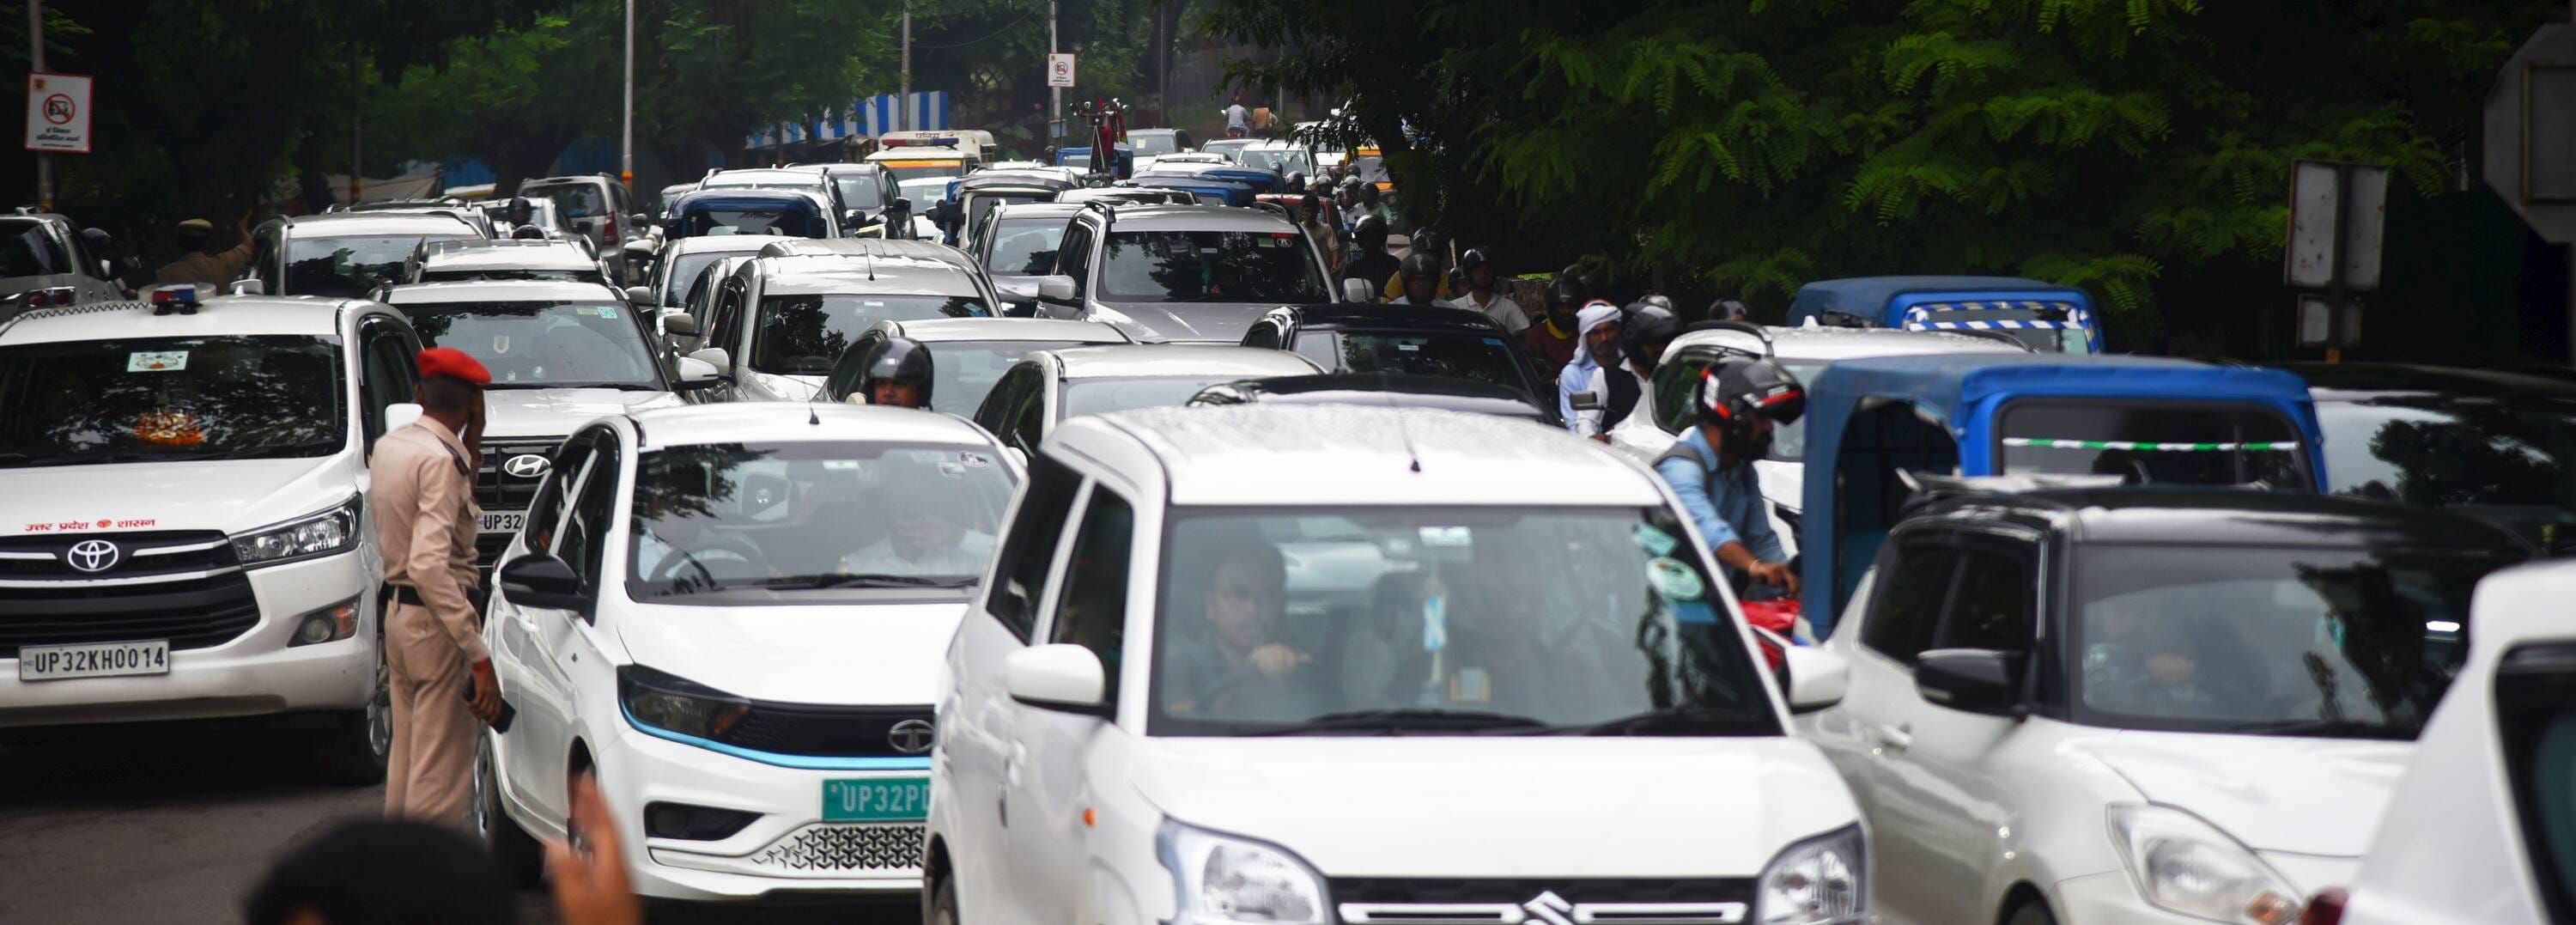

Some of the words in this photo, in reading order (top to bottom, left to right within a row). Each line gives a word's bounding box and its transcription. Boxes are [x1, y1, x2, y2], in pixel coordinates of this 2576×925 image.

[26, 523, 53, 532] उत्तर
[59, 520, 89, 531] प्रदेश
[35, 647, 164, 672] UP32KH0014
